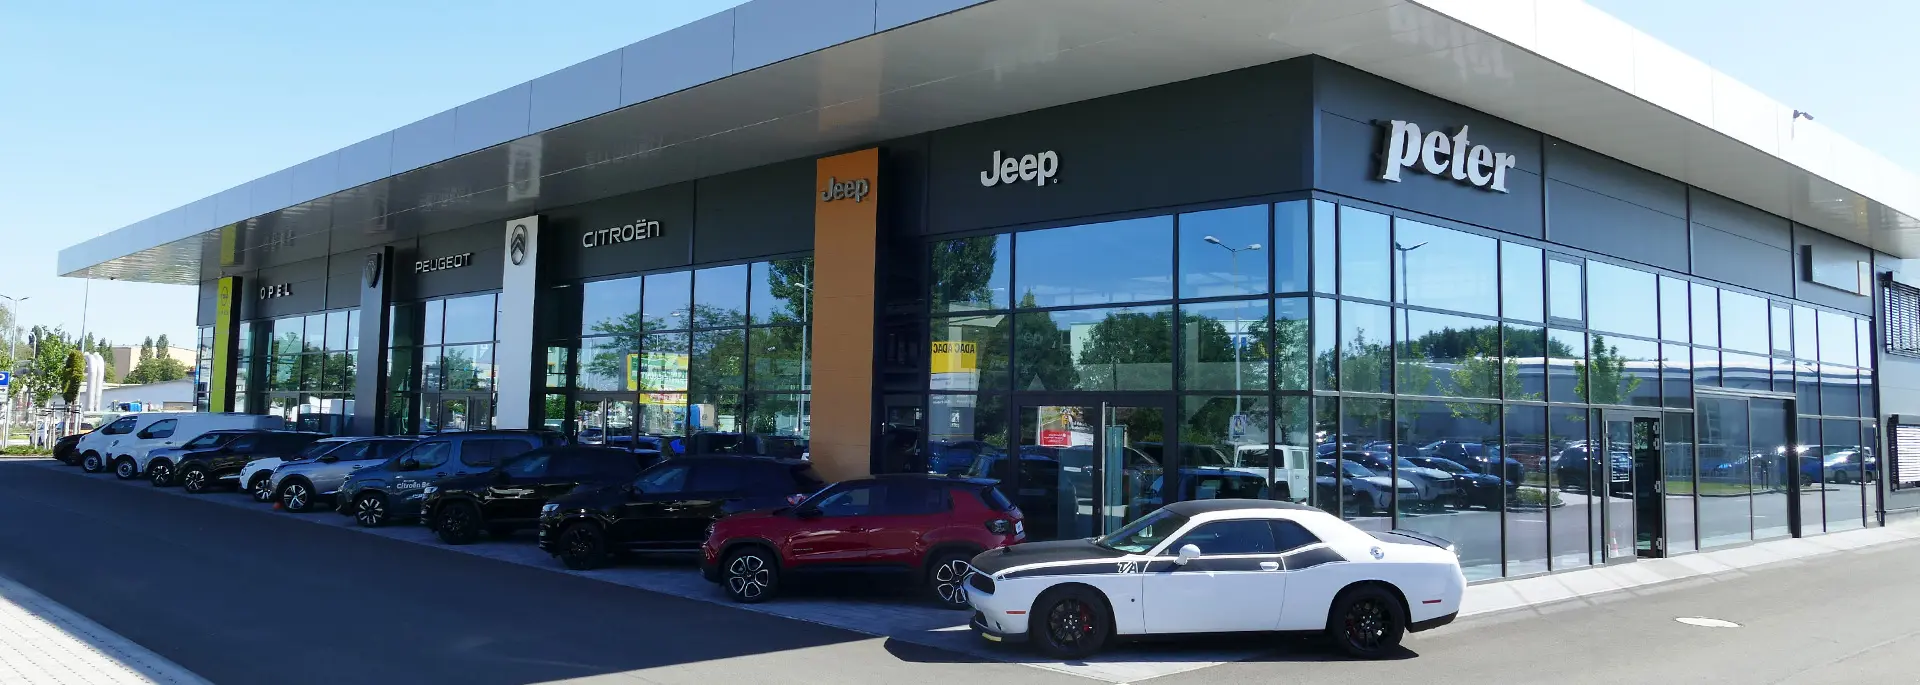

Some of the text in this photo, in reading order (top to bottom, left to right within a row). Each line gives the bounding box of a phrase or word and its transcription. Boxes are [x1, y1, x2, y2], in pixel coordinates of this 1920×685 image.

[980, 149, 1059, 187] Jeep
[1382, 119, 1516, 195] peter
[821, 176, 869, 203] Jeep
[414, 252, 471, 274] PEUGEOT
[260, 282, 290, 300] OPEL
[1117, 561, 1139, 575] T/A
